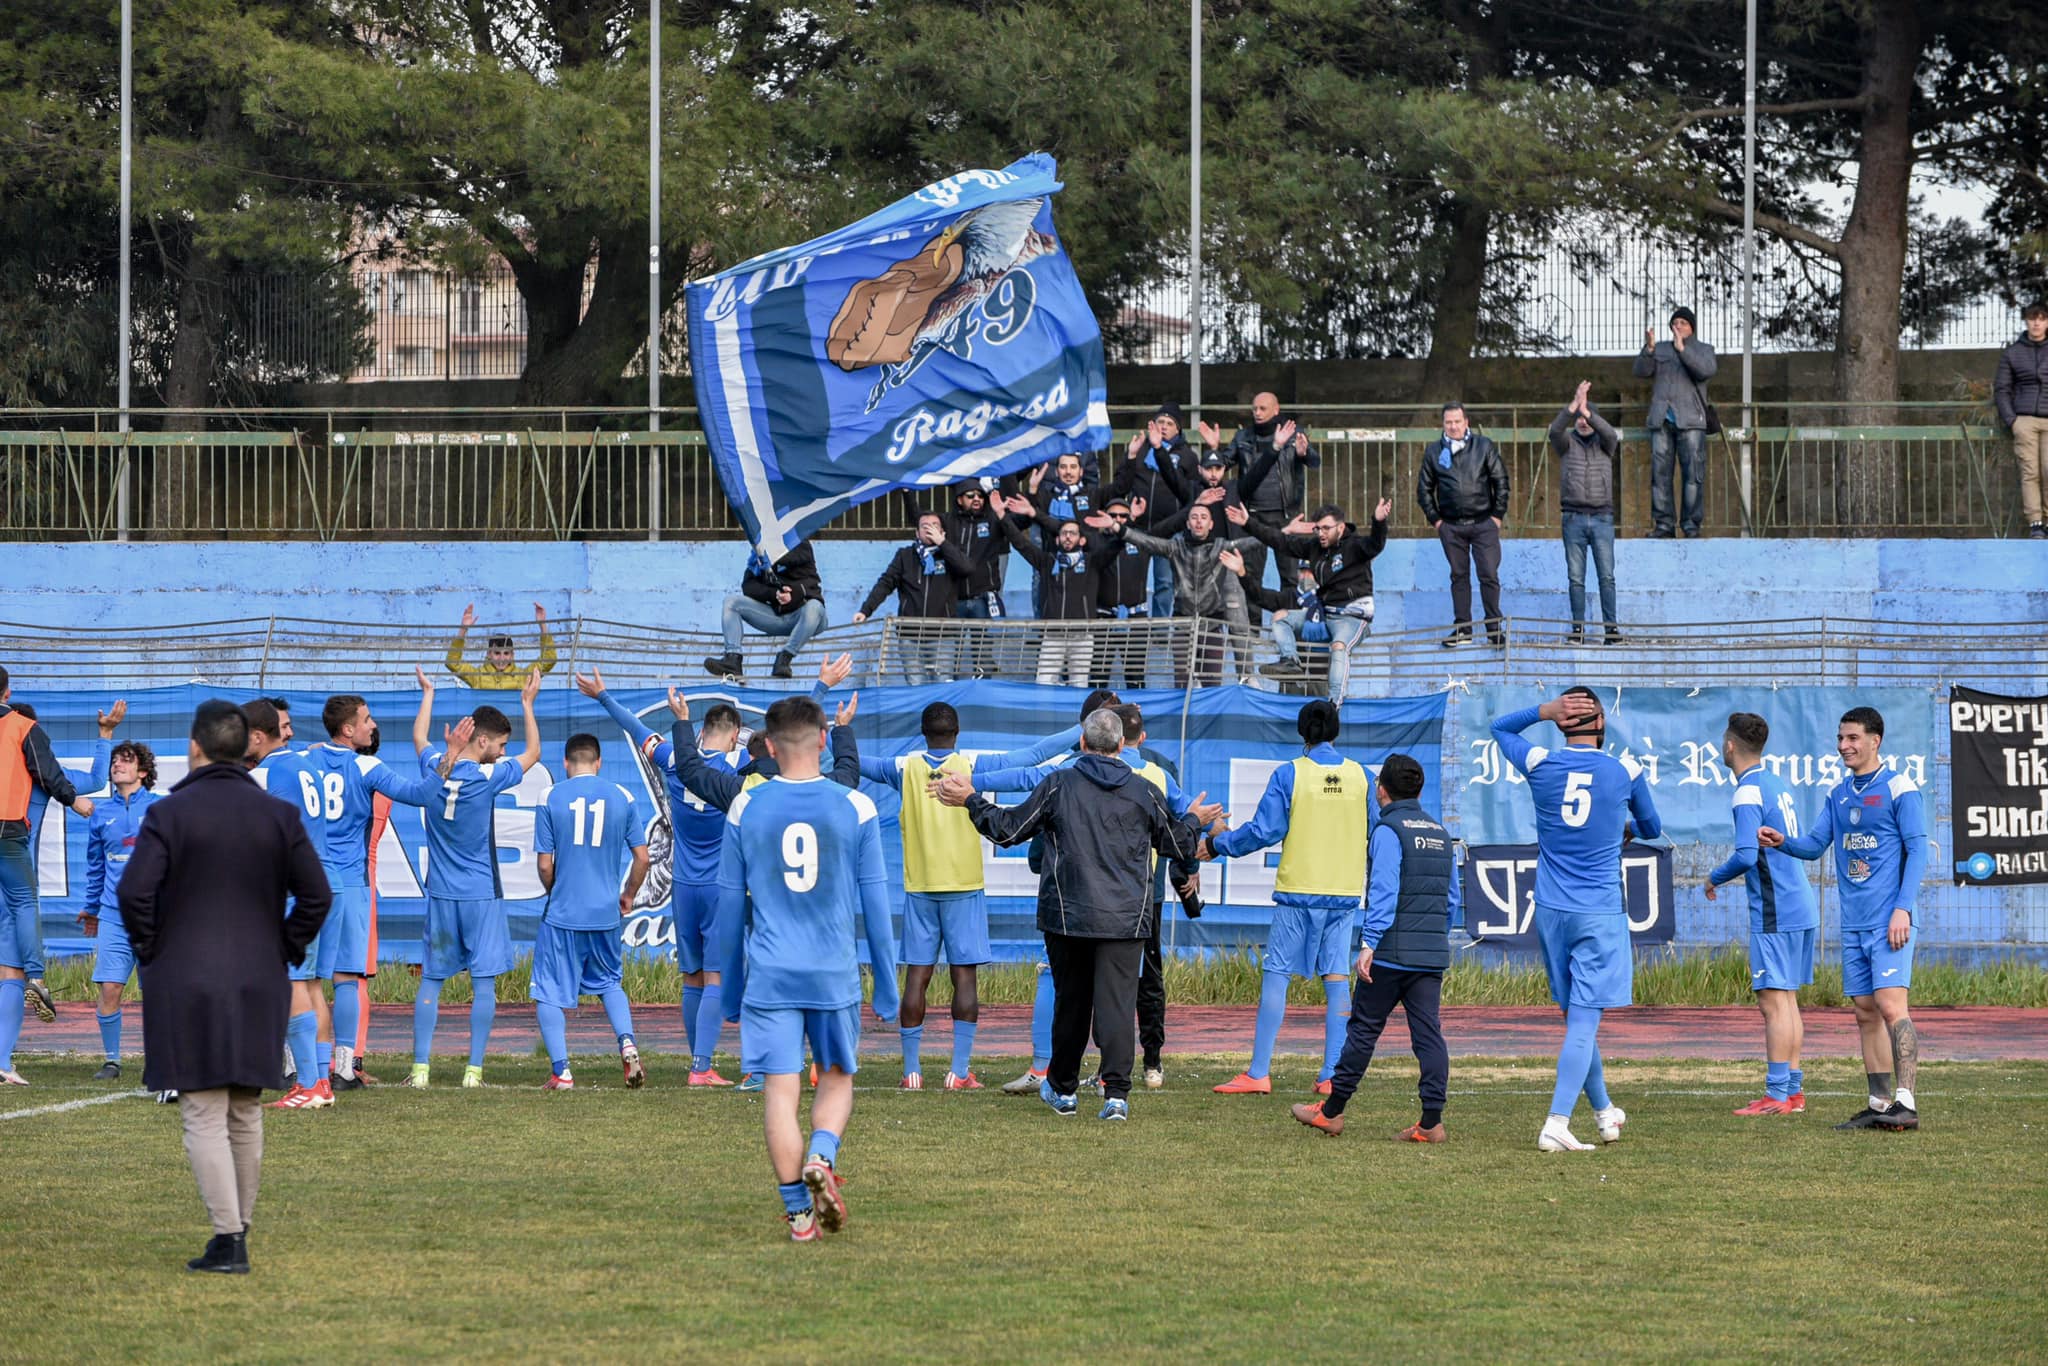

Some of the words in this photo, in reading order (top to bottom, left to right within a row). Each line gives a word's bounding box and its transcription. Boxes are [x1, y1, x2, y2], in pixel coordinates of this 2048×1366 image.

[298, 770, 320, 818] 6
[317, 770, 345, 820] 8
[1561, 772, 1593, 828] 5
[1777, 791, 1799, 839] 16
[569, 797, 605, 848] 11
[782, 822, 818, 893] 9
